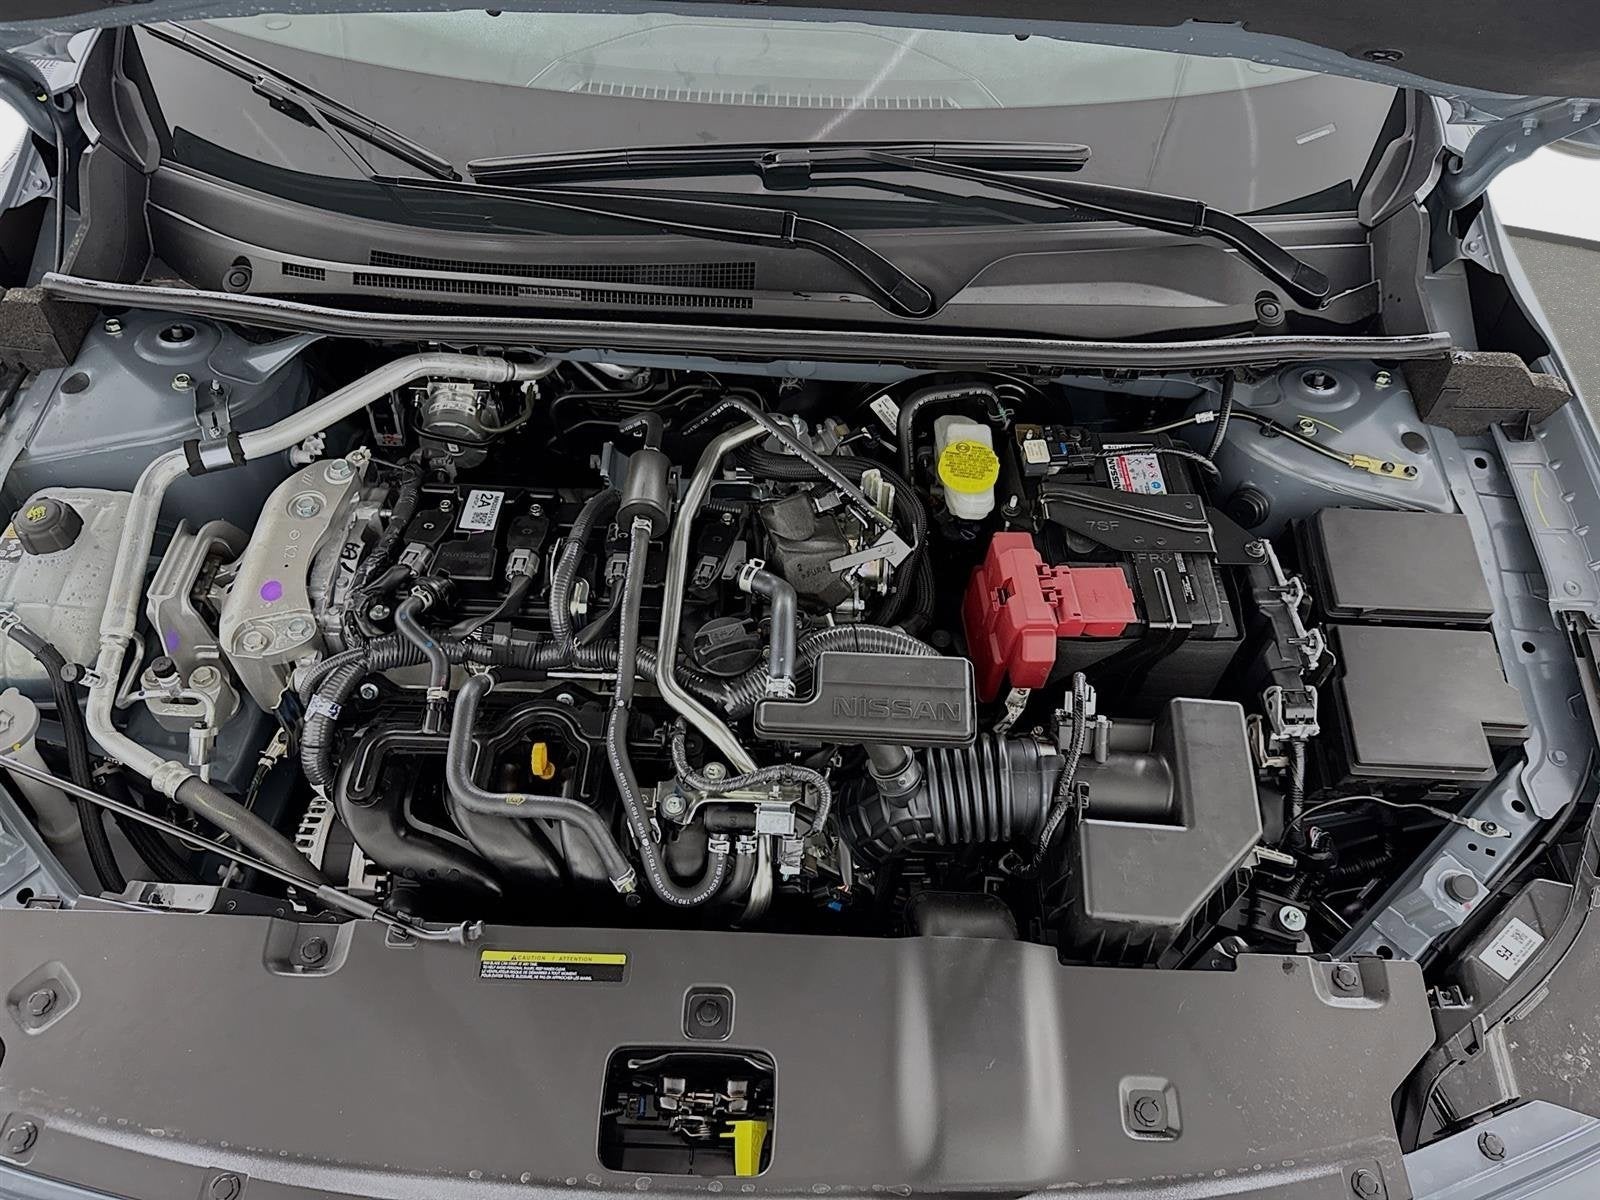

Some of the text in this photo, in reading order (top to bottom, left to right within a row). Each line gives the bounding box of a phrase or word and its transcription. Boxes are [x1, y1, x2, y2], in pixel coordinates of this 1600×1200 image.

[1107, 458, 1122, 490] NISSAN
[478, 493, 494, 508] 2A
[832, 696, 962, 722] NISSAN
[1496, 945, 1514, 961] F5
